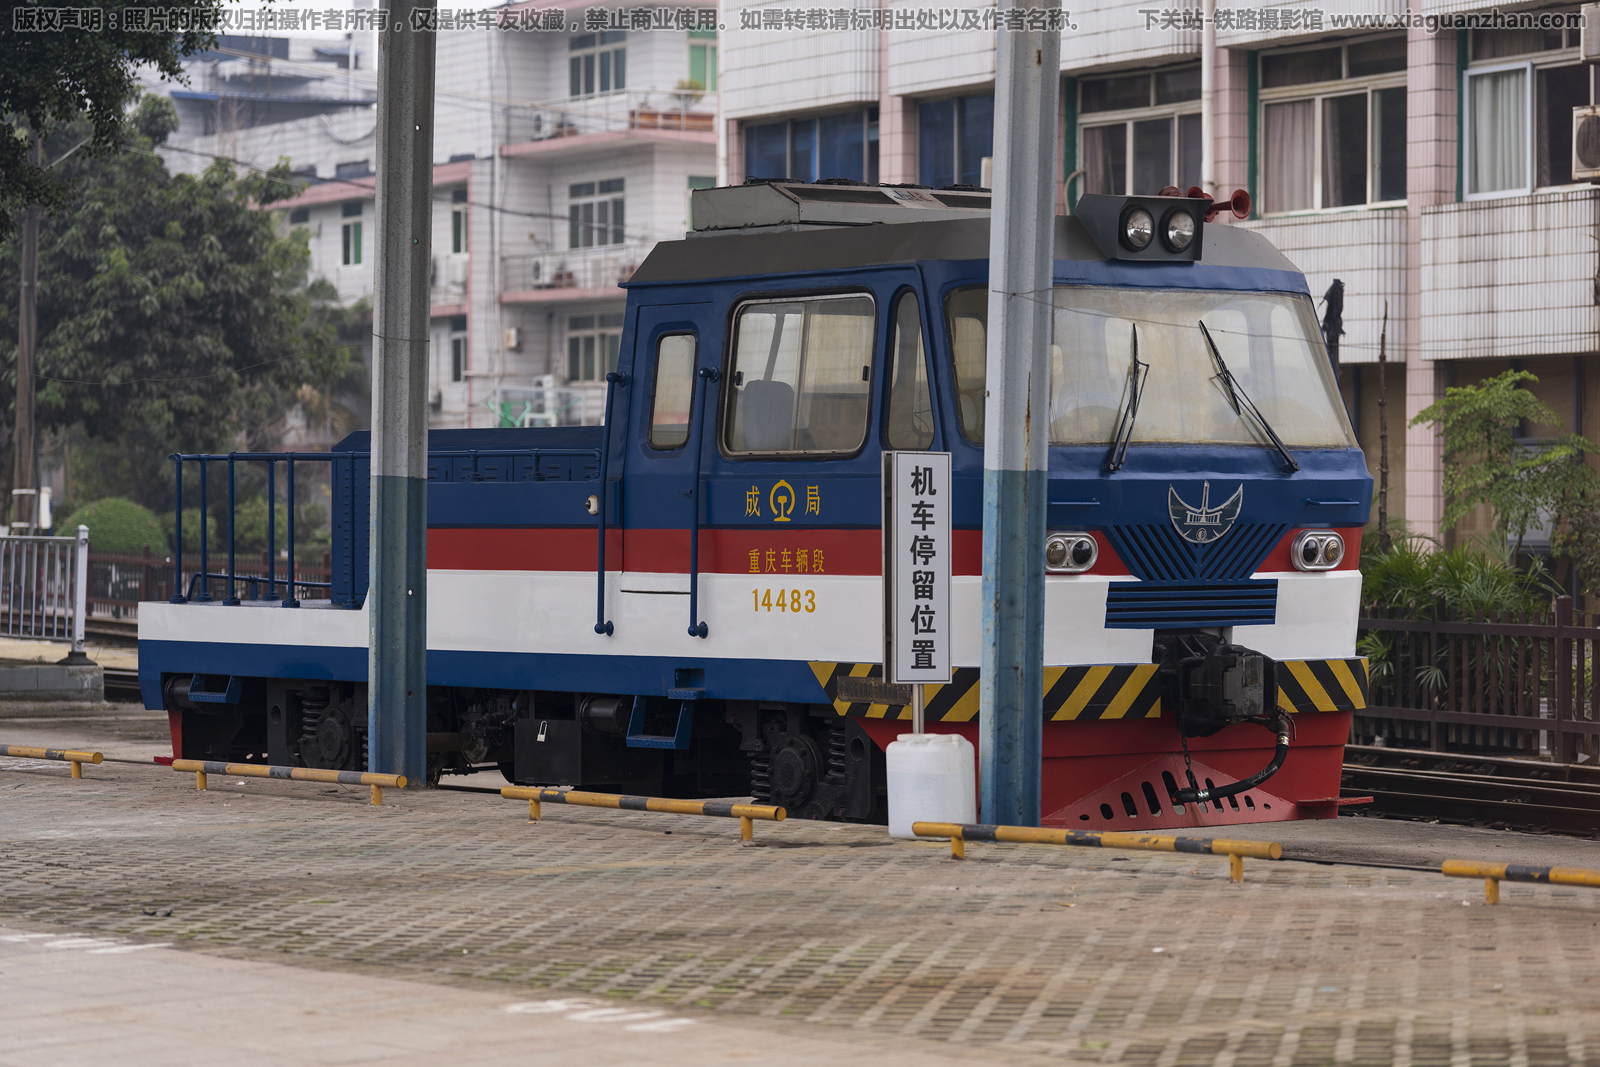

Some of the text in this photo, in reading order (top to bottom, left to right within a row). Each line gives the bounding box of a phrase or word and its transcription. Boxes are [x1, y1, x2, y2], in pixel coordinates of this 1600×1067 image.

[748, 547, 825, 573] 重庆车辆段
[910, 465, 937, 670] 机车停留位置
[752, 588, 816, 613] 14483
